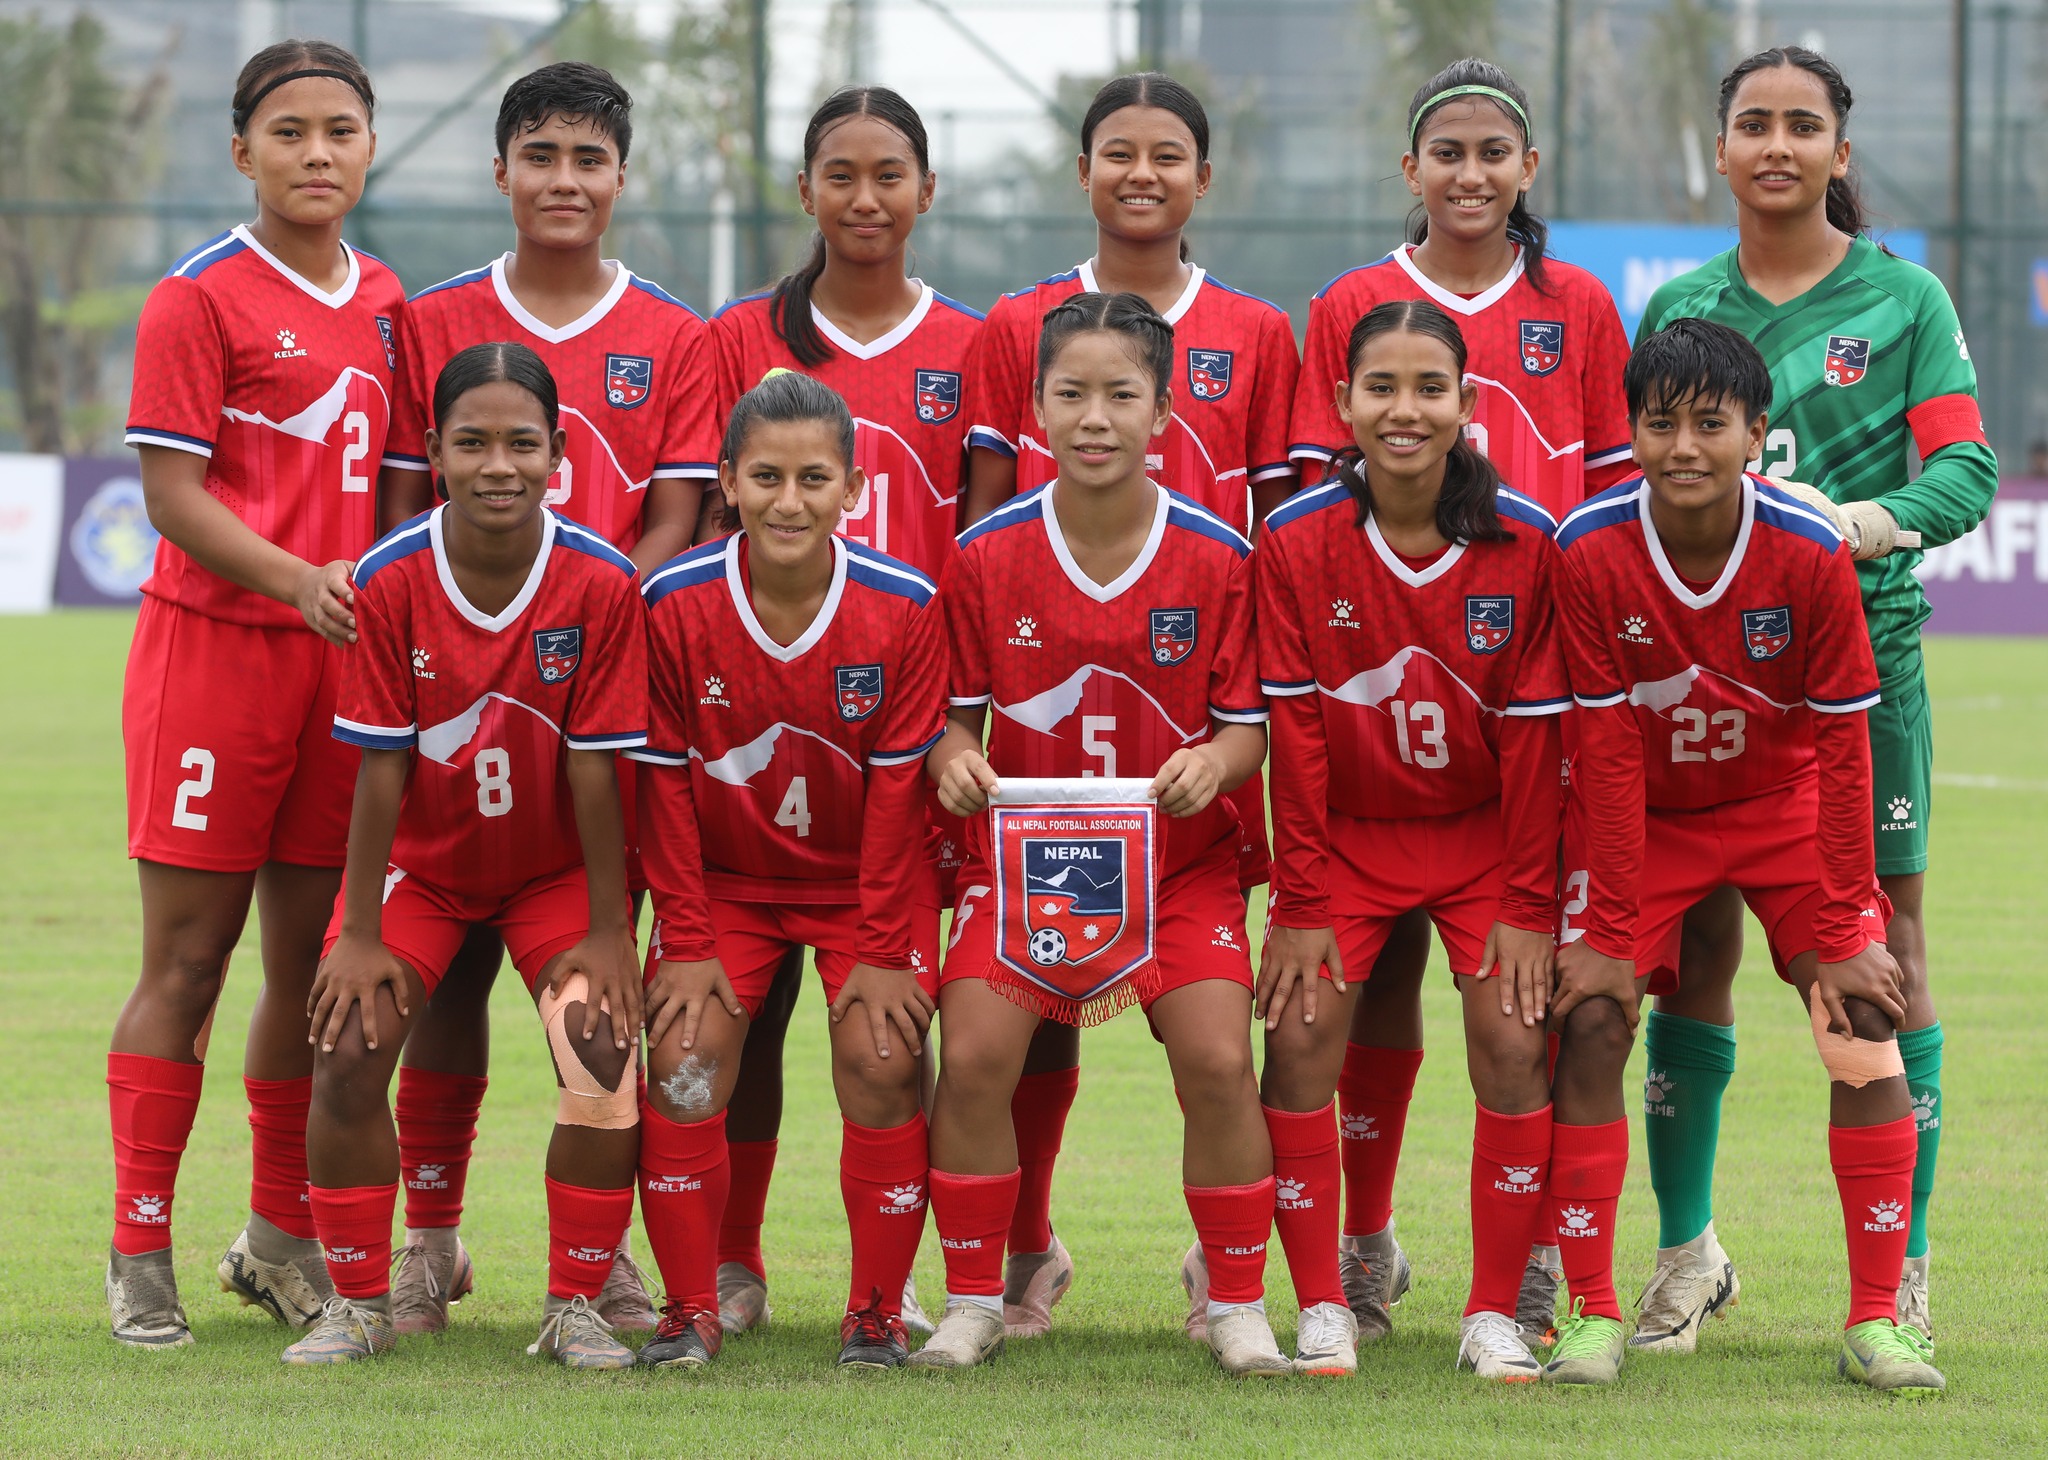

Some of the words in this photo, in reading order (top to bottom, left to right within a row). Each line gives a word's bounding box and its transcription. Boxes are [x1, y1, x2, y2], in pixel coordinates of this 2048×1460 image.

[1838, 339, 1859, 348] NEPAL
[274, 349, 308, 359] KELME
[1201, 354, 1220, 362] NEPAL
[619, 360, 640, 368] NEPAL
[928, 375, 948, 383] NEPAL
[343, 411, 368, 492] 2
[1748, 429, 1796, 478] 2
[1756, 613, 1777, 622] NEPAL
[1328, 619, 1361, 629] KELME
[548, 634, 569, 643] NEPAL
[1008, 637, 1042, 648] KELME
[1617, 633, 1653, 645] KELME
[413, 668, 436, 679] LME
[849, 671, 869, 679] NEPAL
[700, 696, 731, 708] KELME
[1390, 701, 1449, 769] 13
[1671, 706, 1746, 764] 23
[1082, 716, 1116, 778] 5
[474, 747, 513, 818] 8
[171, 747, 216, 832] 2
[774, 776, 812, 838] 4
[1007, 820, 1021, 830] ALL
[1023, 820, 1047, 830] NEPAL
[1050, 820, 1088, 830] FOOTBALL
[1090, 820, 1141, 830] ASSOCIATION
[1881, 821, 1918, 831] KELME
[1044, 846, 1102, 860] NEPAL
[1560, 870, 1589, 945] 2
[1212, 940, 1242, 952] KELME
[1915, 1117, 1939, 1131] LME
[408, 1180, 448, 1190] KELME
[648, 1180, 701, 1193] KELME
[1495, 1181, 1541, 1194] KELME
[880, 1198, 925, 1214] KELME
[1277, 1198, 1314, 1209] ELME
[128, 1211, 167, 1223] KELME
[1558, 1226, 1599, 1238] KELME
[1864, 1221, 1906, 1232] KELME
[942, 1238, 982, 1249] KELME
[1225, 1242, 1265, 1255] KELME
[326, 1250, 367, 1262] KELME
[568, 1248, 611, 1261] KELME
